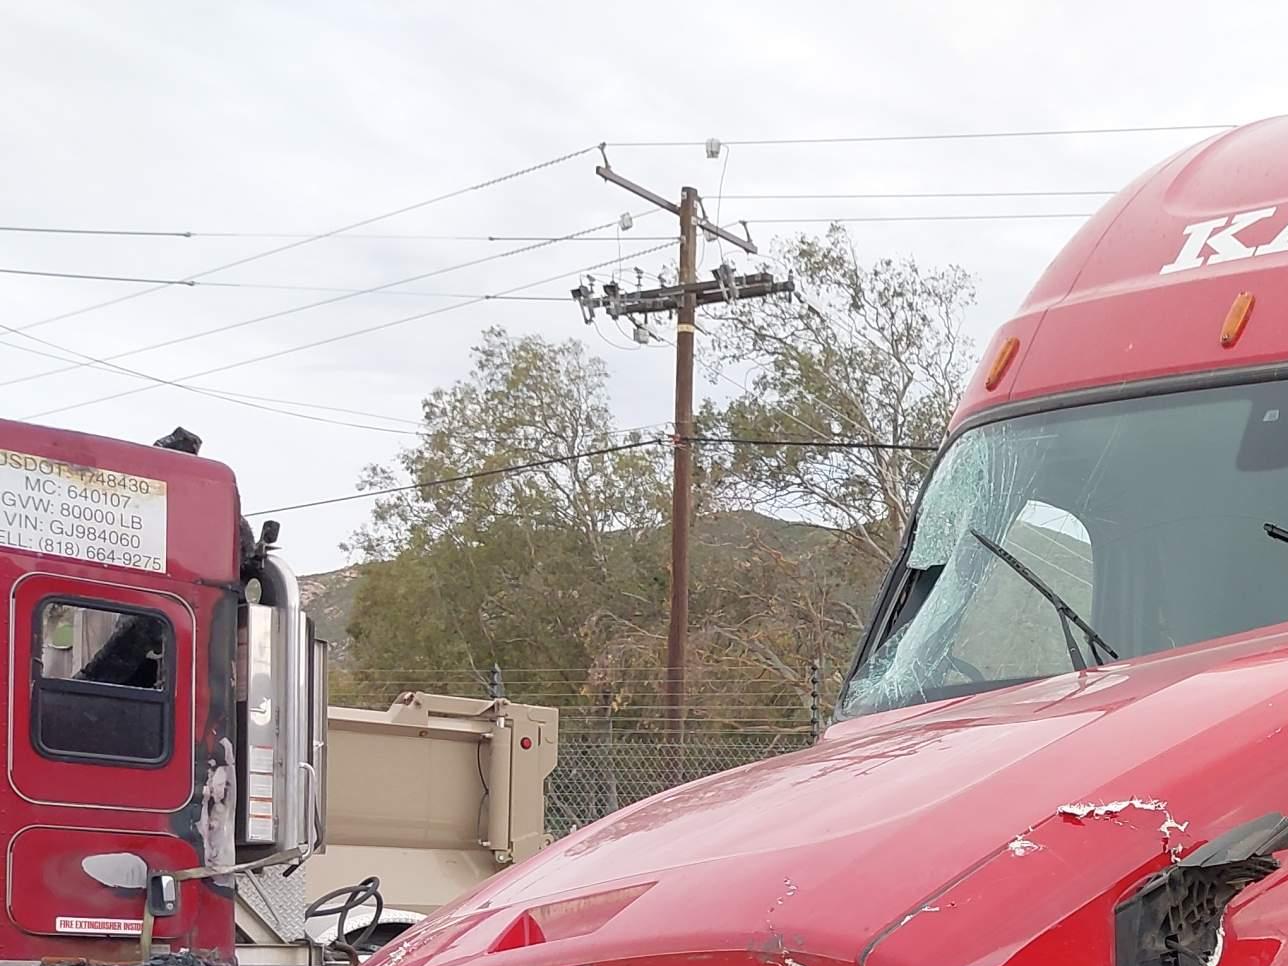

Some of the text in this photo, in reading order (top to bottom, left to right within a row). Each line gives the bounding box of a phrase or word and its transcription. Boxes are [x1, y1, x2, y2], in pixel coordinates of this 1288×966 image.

[25, 476, 131, 509] MC: 640107
[2, 491, 143, 530] GVW: 80000 LB
[4, 511, 140, 549] VIN: GJ984060
[39, 538, 80, 557] (818)
[86, 546, 161, 571] 664-9275
[60, 920, 73, 929] FIRE
[75, 920, 122, 930] EXTINGUISHER
